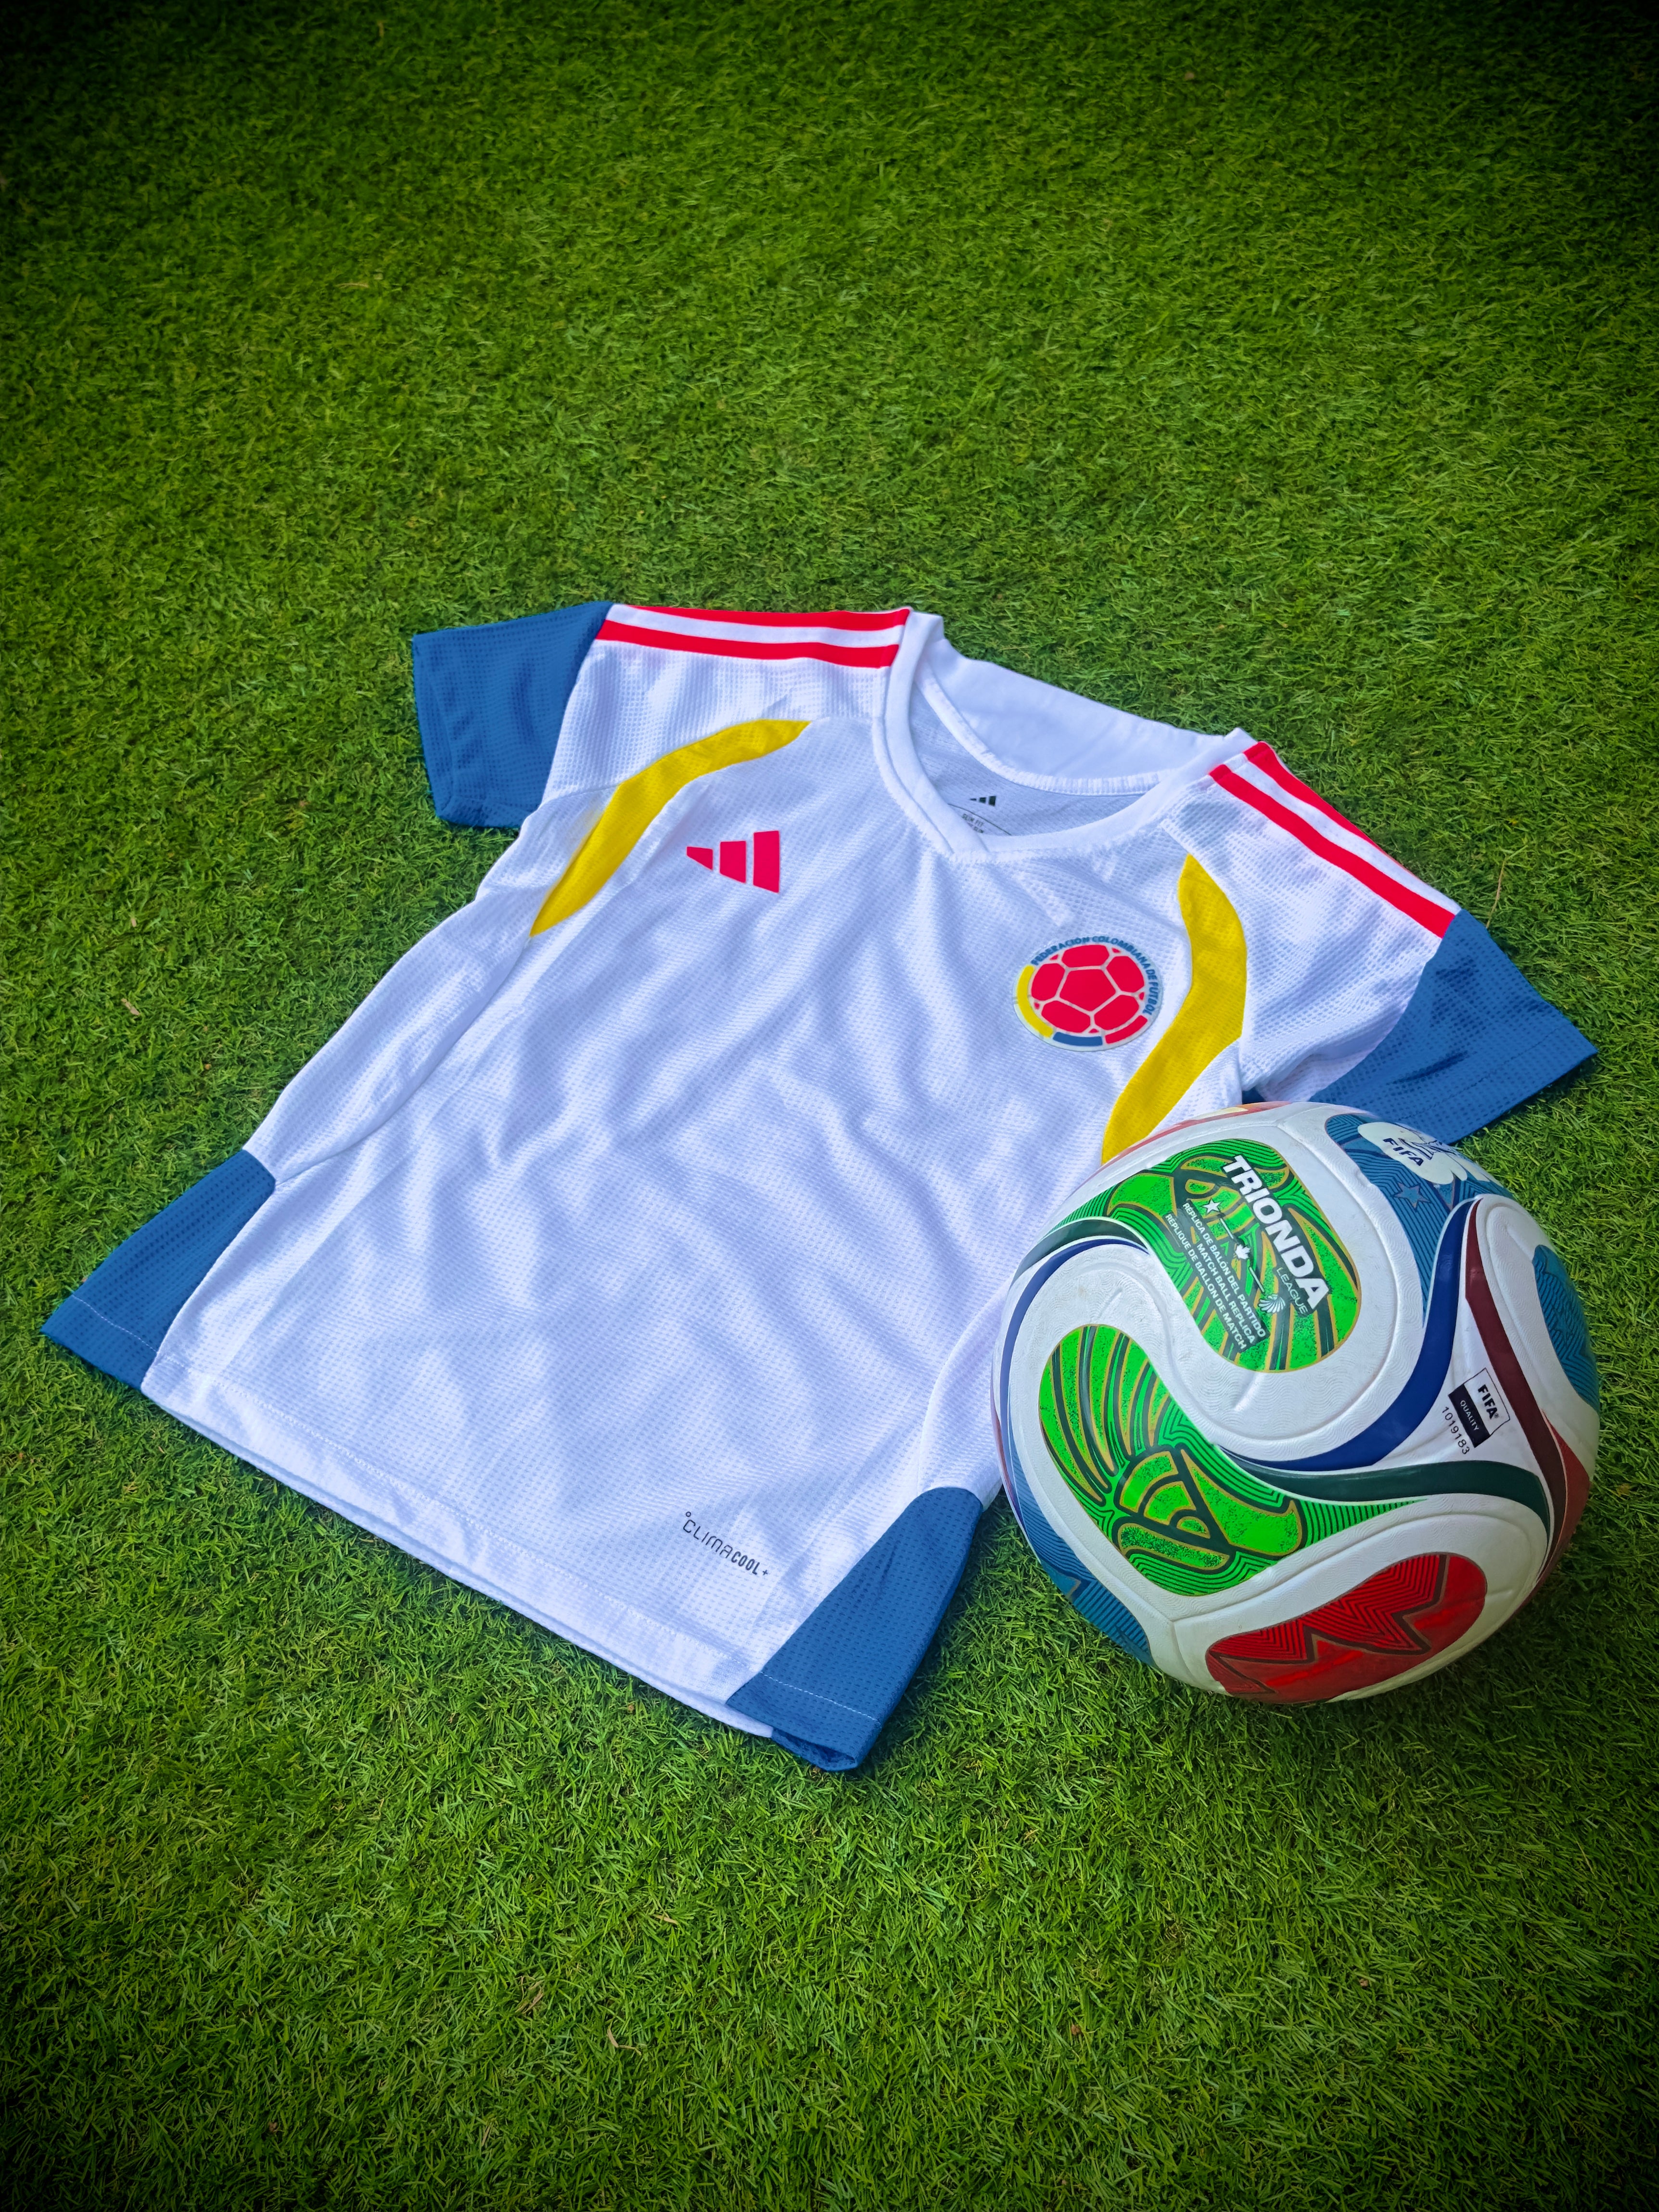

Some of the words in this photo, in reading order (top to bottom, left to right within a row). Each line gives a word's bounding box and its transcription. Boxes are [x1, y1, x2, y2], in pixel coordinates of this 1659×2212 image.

[1092, 936, 1151, 969] COLOMBIANA
[1146, 969, 1158, 980] DE
[1382, 1138, 1424, 1167] FIFA
[1223, 1154, 1329, 1309] TRIONDA
[1187, 1248, 1199, 1262] DE
[1195, 1261, 1219, 1299] BALLON
[1215, 1297, 1226, 1313] DE
[1223, 1312, 1247, 1349] MATCH
[1196, 1243, 1219, 1276] MATCH
[1214, 1275, 1231, 1302] BALL
[1228, 1300, 1255, 1344] REPLICA
[1202, 1233, 1213, 1246] DE
[1227, 1275, 1240, 1295] DEL
[1237, 1293, 1266, 1337] PARTIDO
[1276, 1267, 1308, 1314] LEAGUE
[1442, 1406, 1470, 1455] 1019183
[1460, 1400, 1480, 1432] QUALITY
